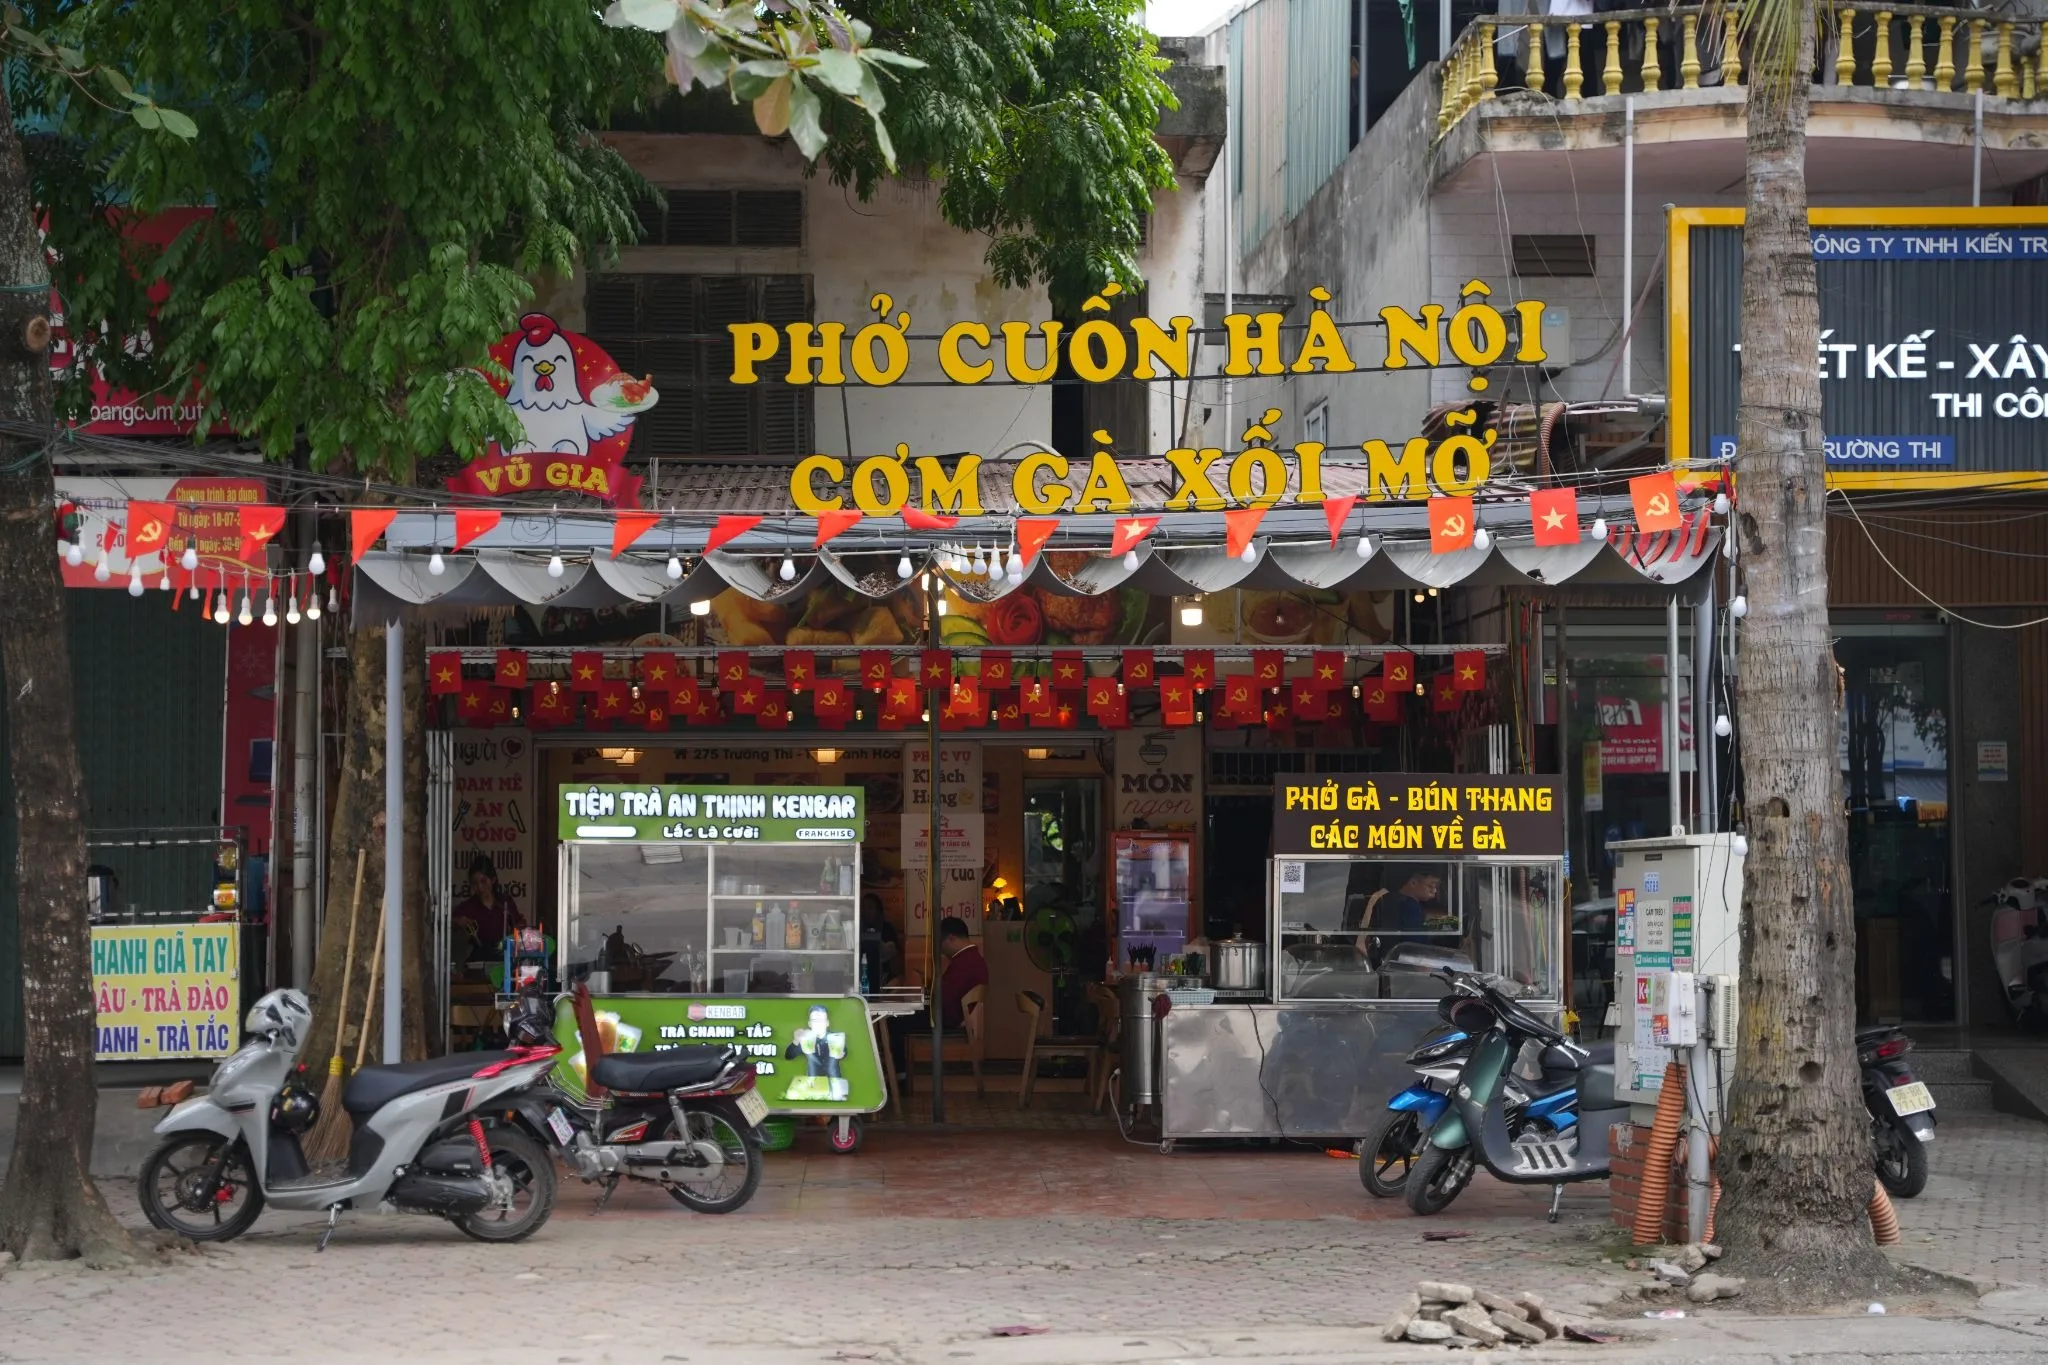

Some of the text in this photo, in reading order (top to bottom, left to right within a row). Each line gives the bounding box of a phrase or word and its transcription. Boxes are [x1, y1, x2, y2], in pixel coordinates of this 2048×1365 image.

[1811, 234, 1860, 254] ÔNG
[1866, 238, 1895, 253] TY
[1902, 237, 1957, 253] TNHH
[1965, 232, 2013, 253] KIẾN
[727, 279, 1547, 392] PHỞ CUỐN HÀ NỘI
[1866, 329, 1936, 379] KẾ
[1930, 386, 2048, 418] THI CÔ
[789, 408, 1498, 517] CƠM GÀ XỐI MỠ
[1822, 439, 1942, 459] RƯỜNG THI
[475, 457, 611, 495] VŨ GIA
[565, 785, 857, 824] TIỆM TRÀ AN THỊNH KENBAR
[1286, 779, 1339, 810] PHỞ
[1347, 781, 1380, 811] GÀ
[1408, 781, 1458, 811] BÚN
[1465, 787, 1552, 811] THANG
[798, 829, 853, 838] FRANCHISE
[1310, 815, 1507, 849] CÁC MÓN VỀ GÀ
[93, 931, 228, 975] HANH GIÃ TAY
[141, 980, 182, 1012] TRÀ
[187, 979, 229, 1011] ĐÀO
[707, 1006, 745, 1018] KENBAR
[96, 1027, 138, 1053] ANH
[156, 1020, 190, 1052] TRÀ
[195, 1014, 229, 1051] TẮC
[660, 1024, 686, 1038] TRÀ
[688, 1026, 735, 1038] CHANH
